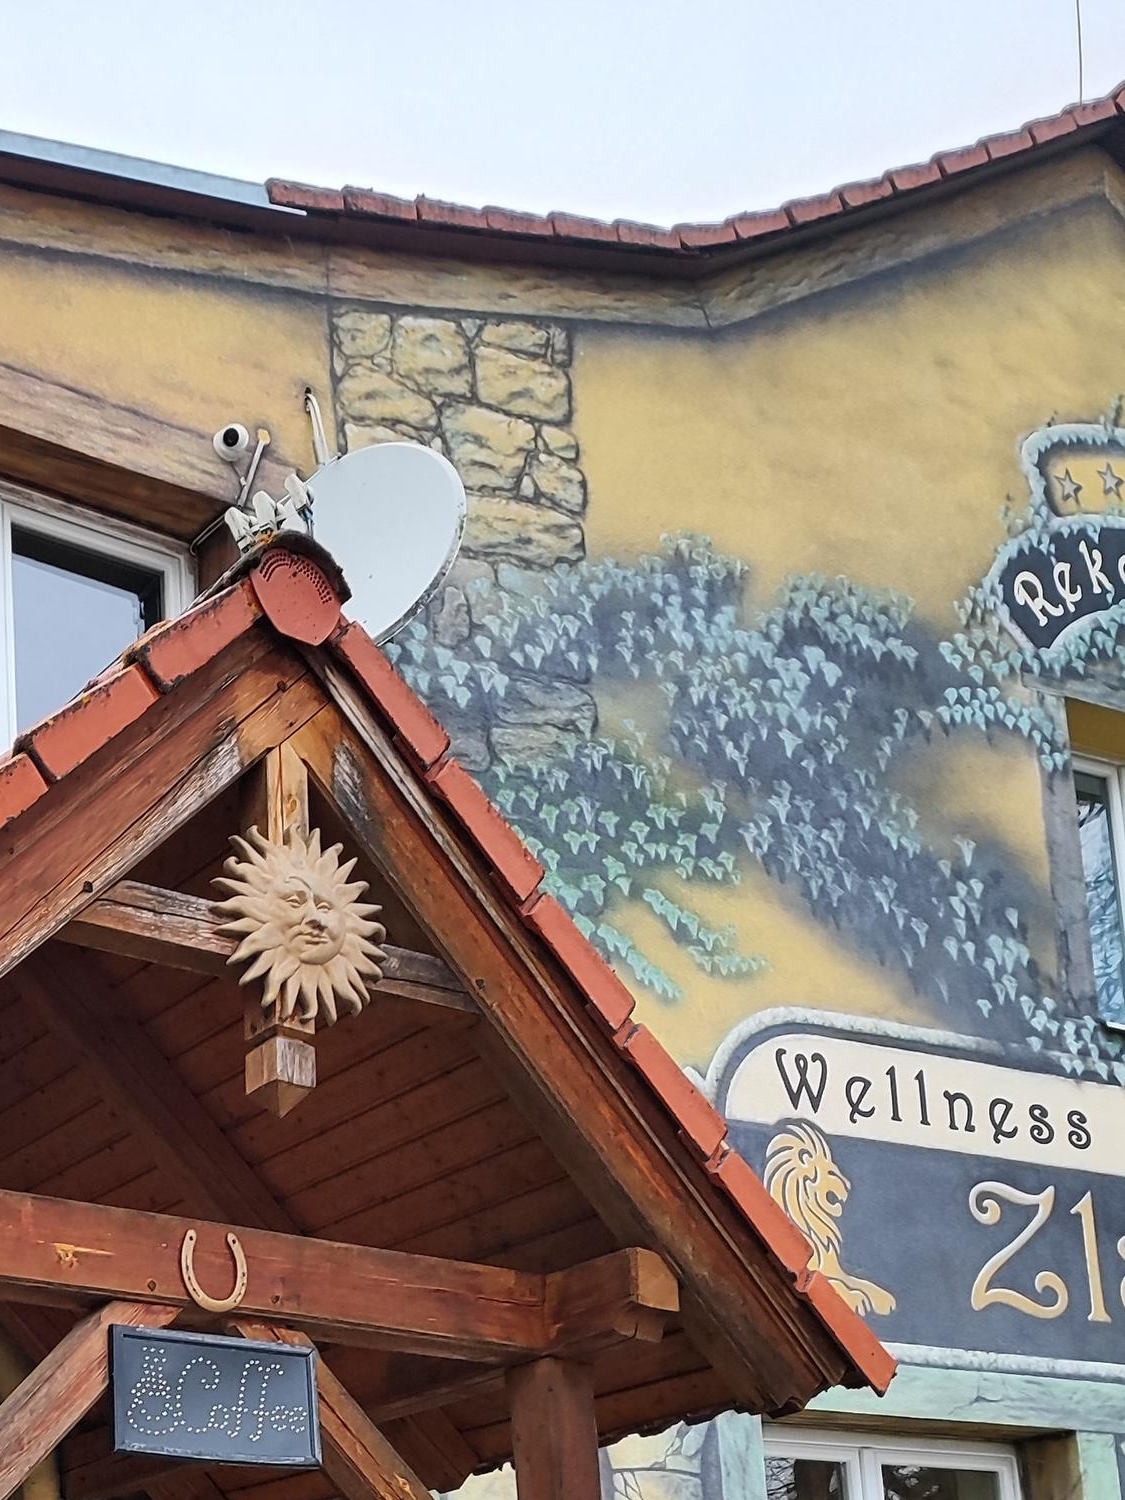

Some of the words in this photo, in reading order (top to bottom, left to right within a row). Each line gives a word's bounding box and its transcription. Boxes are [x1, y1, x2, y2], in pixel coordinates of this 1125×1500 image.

[1013, 540, 1125, 627] Rek
[775, 1048, 1092, 1150] Wellness
[968, 1180, 1125, 1323] Zl
[176, 1356, 307, 1442] Coffee
